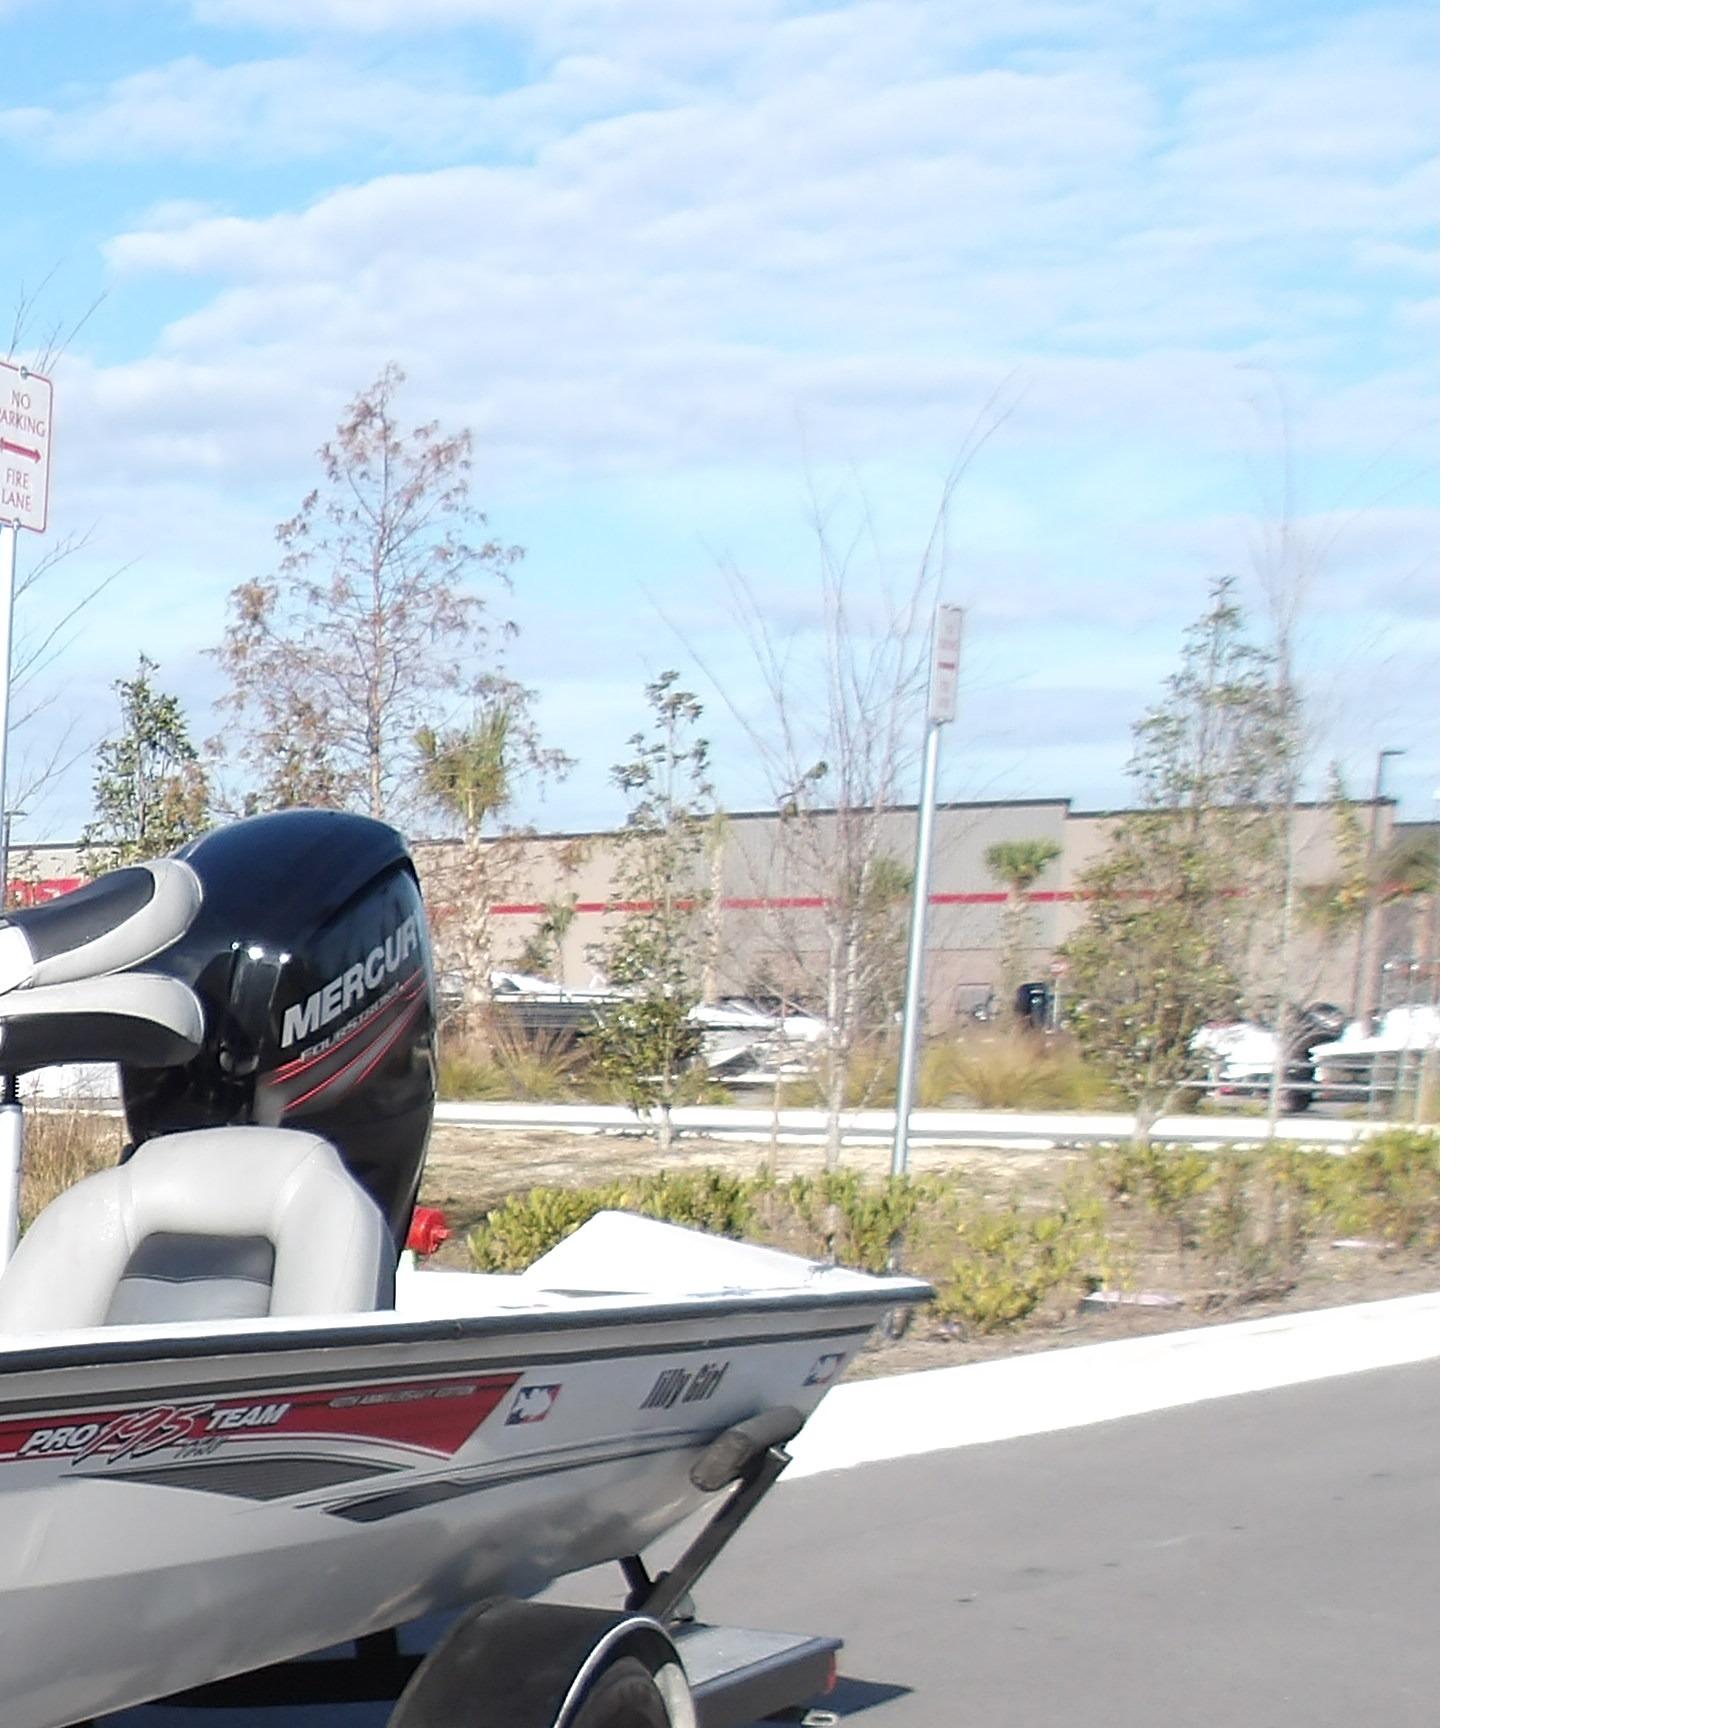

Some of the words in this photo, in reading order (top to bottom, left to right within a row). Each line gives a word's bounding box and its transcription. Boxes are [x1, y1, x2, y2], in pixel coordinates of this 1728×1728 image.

[11, 389, 31, 410] NO
[5, 467, 29, 490] FIRE
[0, 487, 32, 513] LANE
[18, 1424, 99, 1456] PRO
[72, 1403, 215, 1466] 195
[205, 1403, 291, 1431] TEAM
